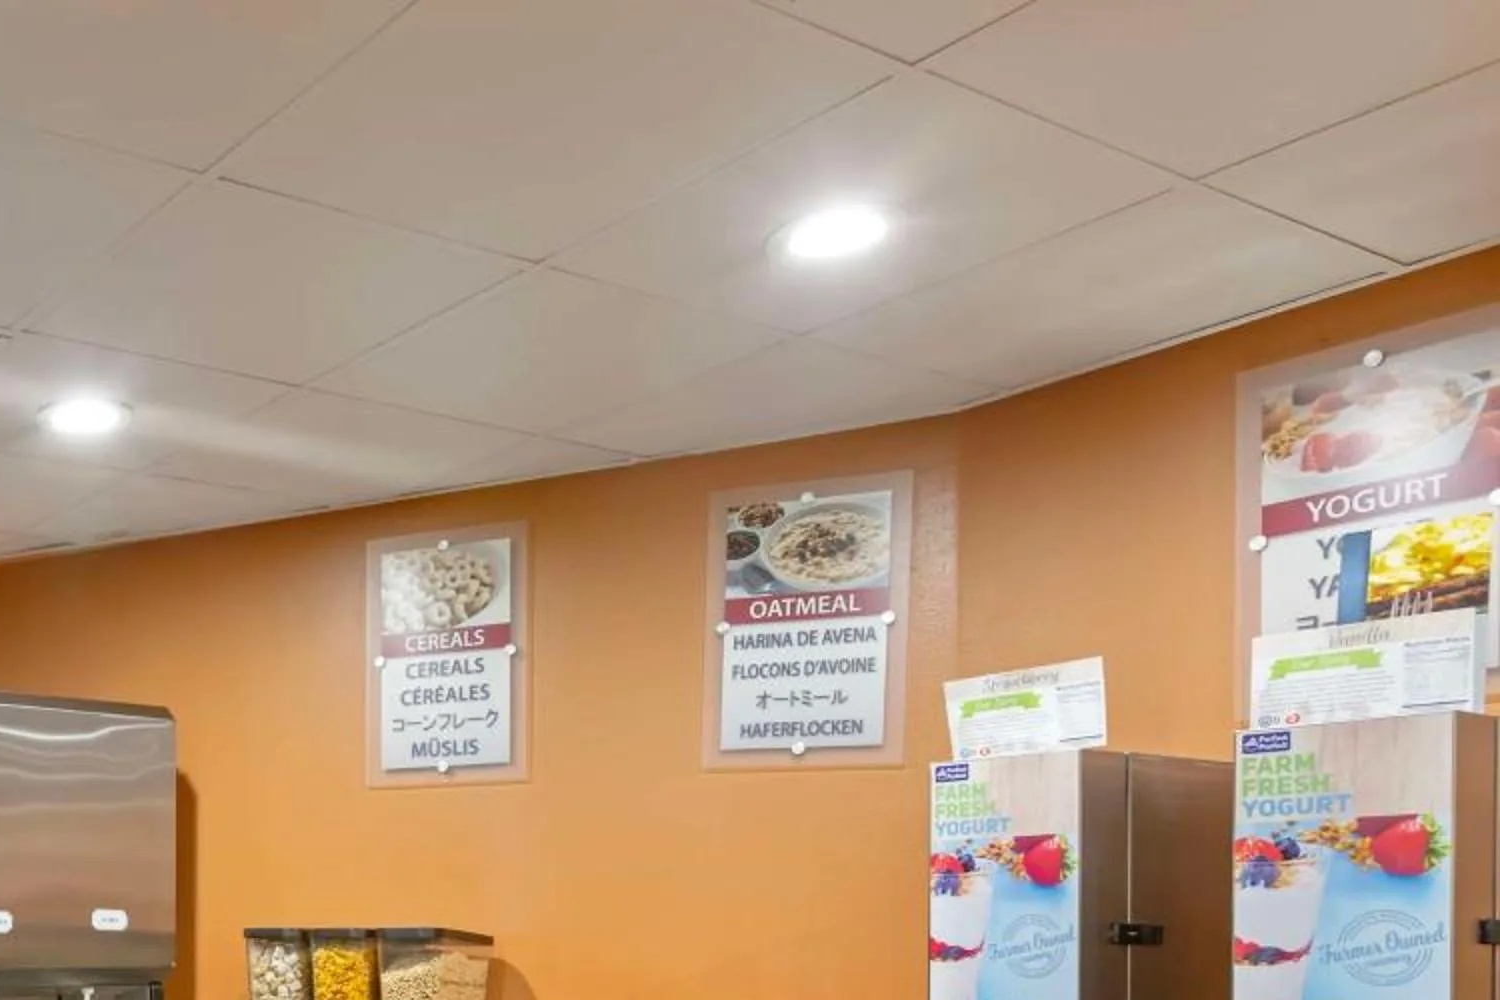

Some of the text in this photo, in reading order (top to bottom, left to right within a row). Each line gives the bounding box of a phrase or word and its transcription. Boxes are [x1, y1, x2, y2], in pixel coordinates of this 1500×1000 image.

[1306, 473, 1447, 523] YOGURT
[750, 592, 861, 620] OATMEAL
[405, 628, 485, 653] CEREALS
[733, 625, 877, 651] HARINA DE AVENA
[405, 657, 485, 680] CEREALS
[731, 656, 876, 681] FLOCONS D'AVOINE
[400, 683, 490, 707] CÉRÉALES
[755, 689, 849, 710] オートミール
[740, 718, 863, 740] HAFERFLOCKEN
[411, 737, 480, 760] MÜSLIS
[1241, 753, 1316, 777] FARM
[935, 782, 986, 801] FARM
[1241, 774, 1330, 798] FRESH
[935, 801, 996, 819] FRESH
[1241, 793, 1351, 818] YOGURT
[934, 817, 1012, 836] YOGURT
